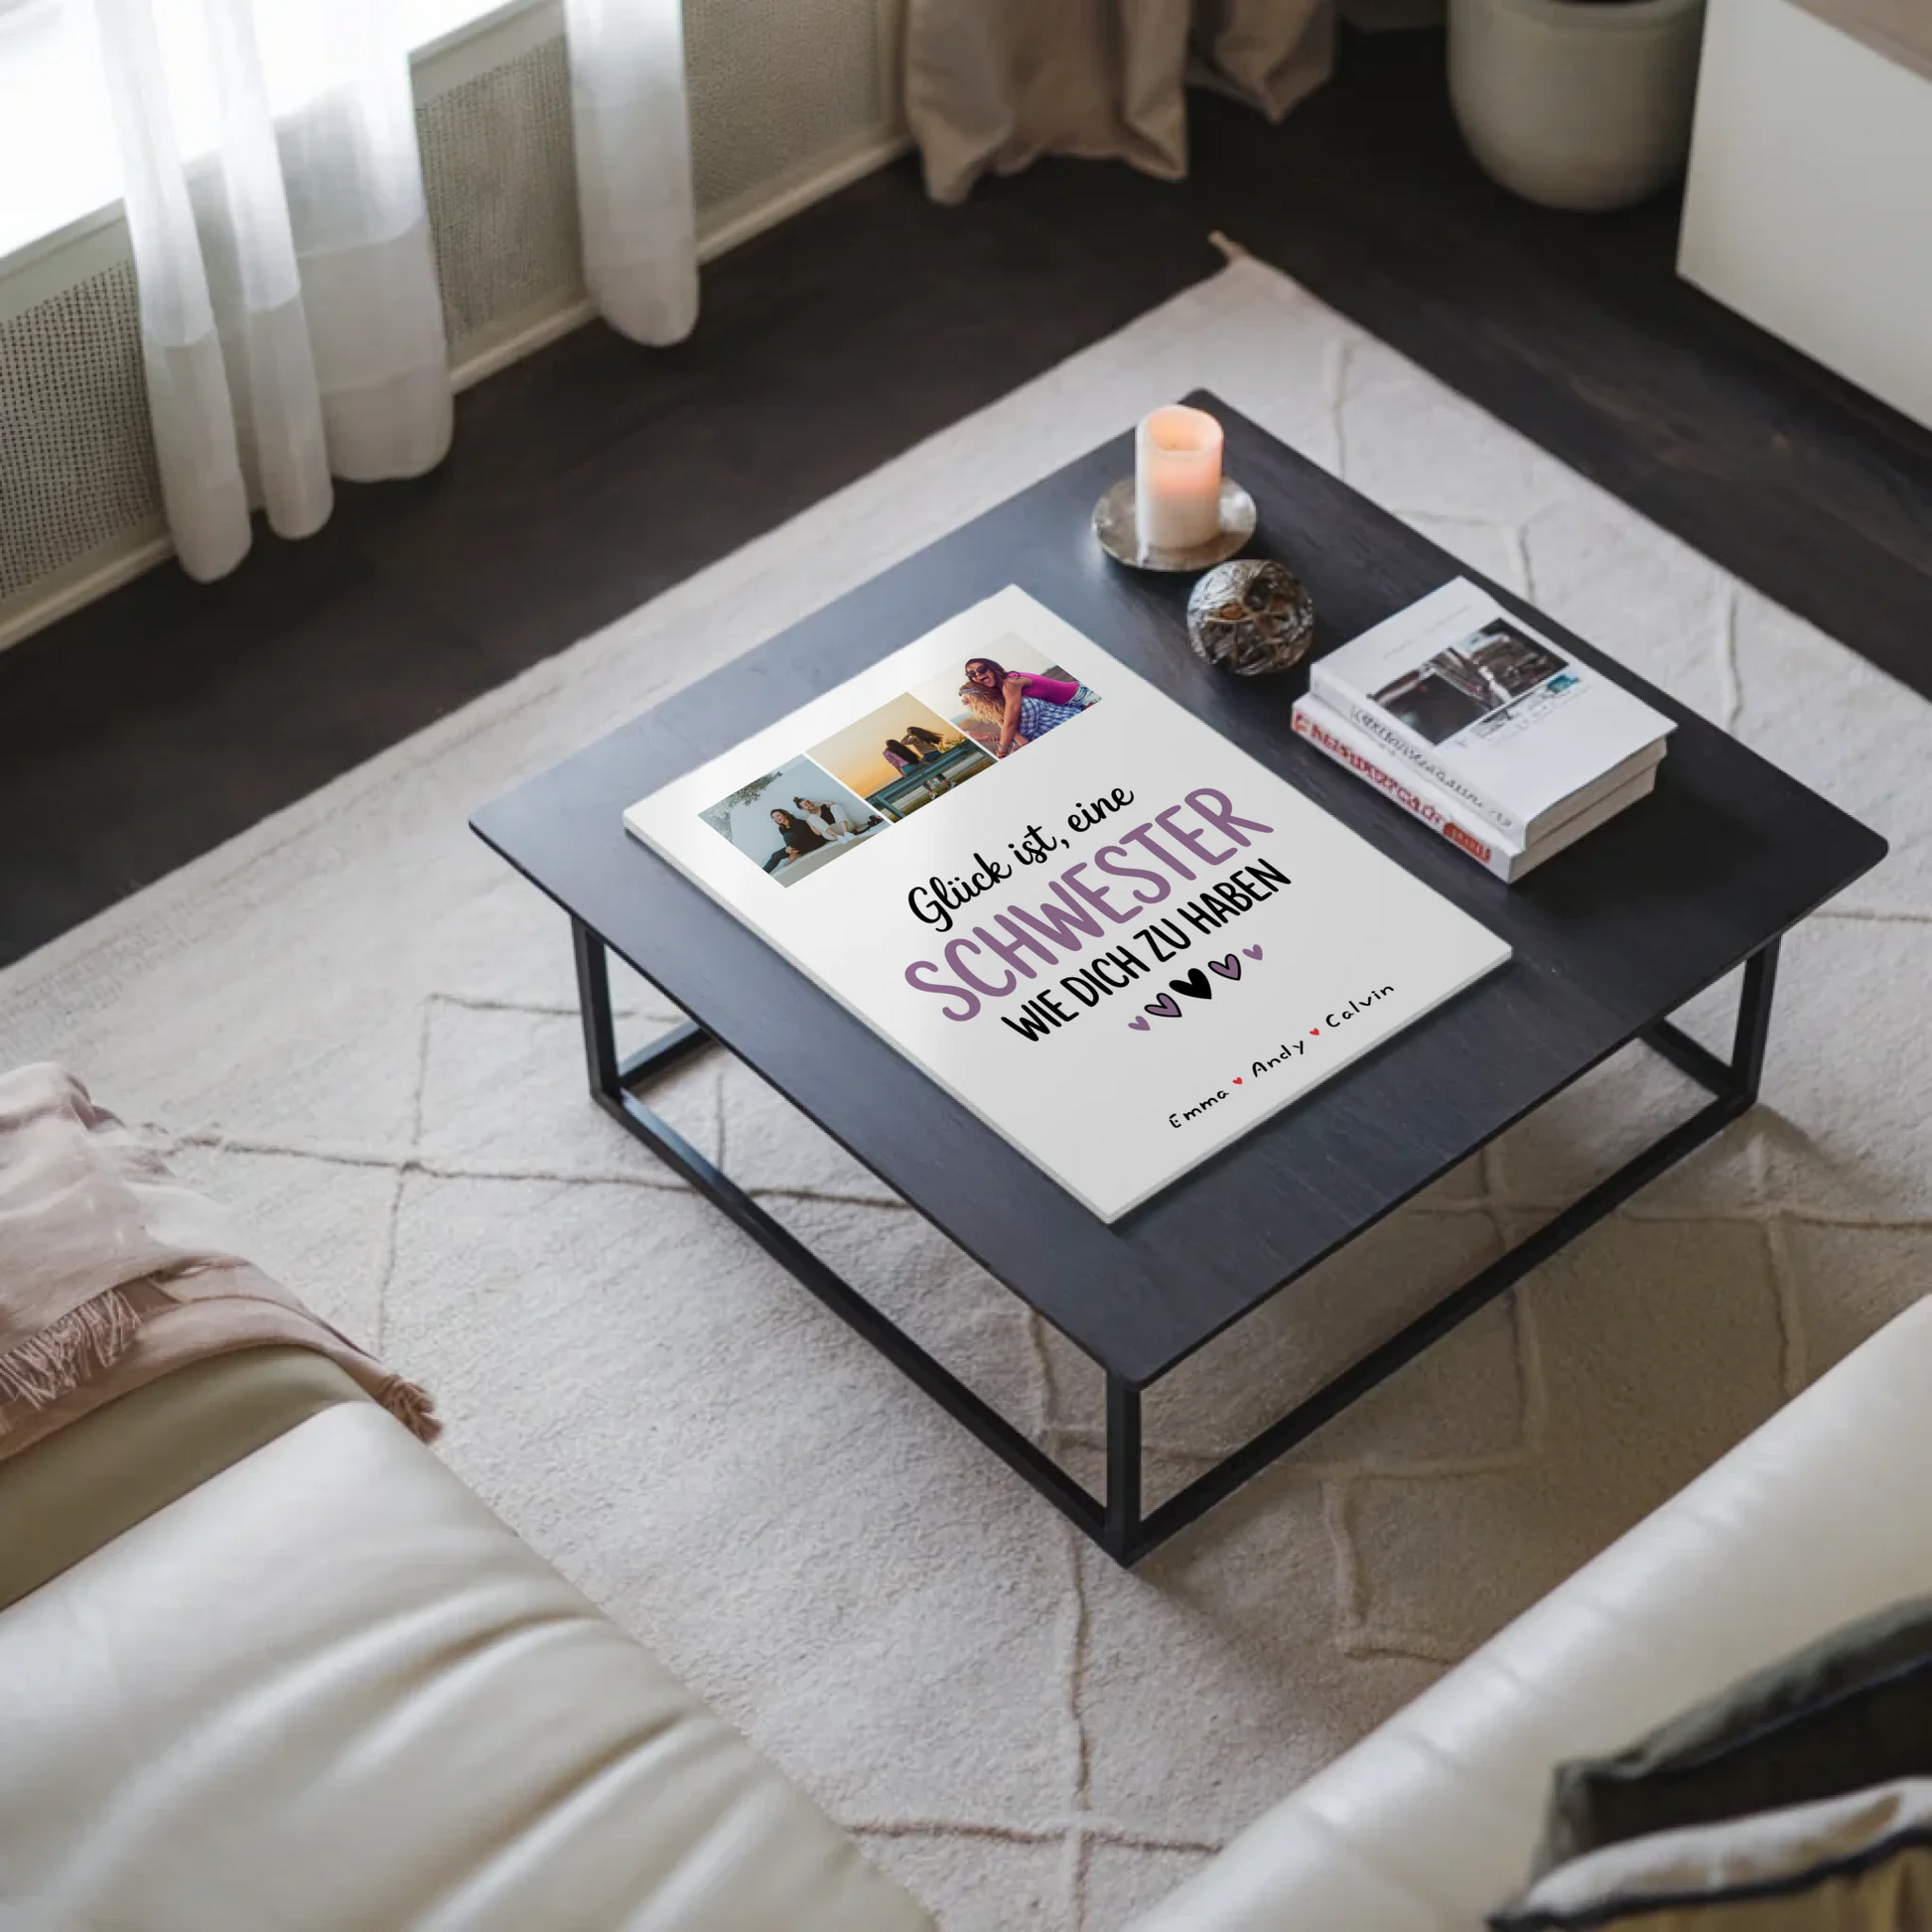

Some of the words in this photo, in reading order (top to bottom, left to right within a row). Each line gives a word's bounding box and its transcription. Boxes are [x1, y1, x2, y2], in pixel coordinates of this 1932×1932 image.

[905, 788, 1274, 1022] SCHWESTER
[908, 853, 1012, 932] Glück
[1008, 825, 1069, 865] ist,
[1068, 788, 1134, 832] eine
[1001, 989, 1079, 1041] WIE
[1059, 945, 1151, 1007] DICH
[1133, 918, 1191, 962] ZU
[1176, 858, 1292, 934] HABEN
[1170, 1091, 1229, 1128] Emma
[1252, 1040, 1304, 1077] Andy
[1325, 986, 1394, 1028] Calvin
